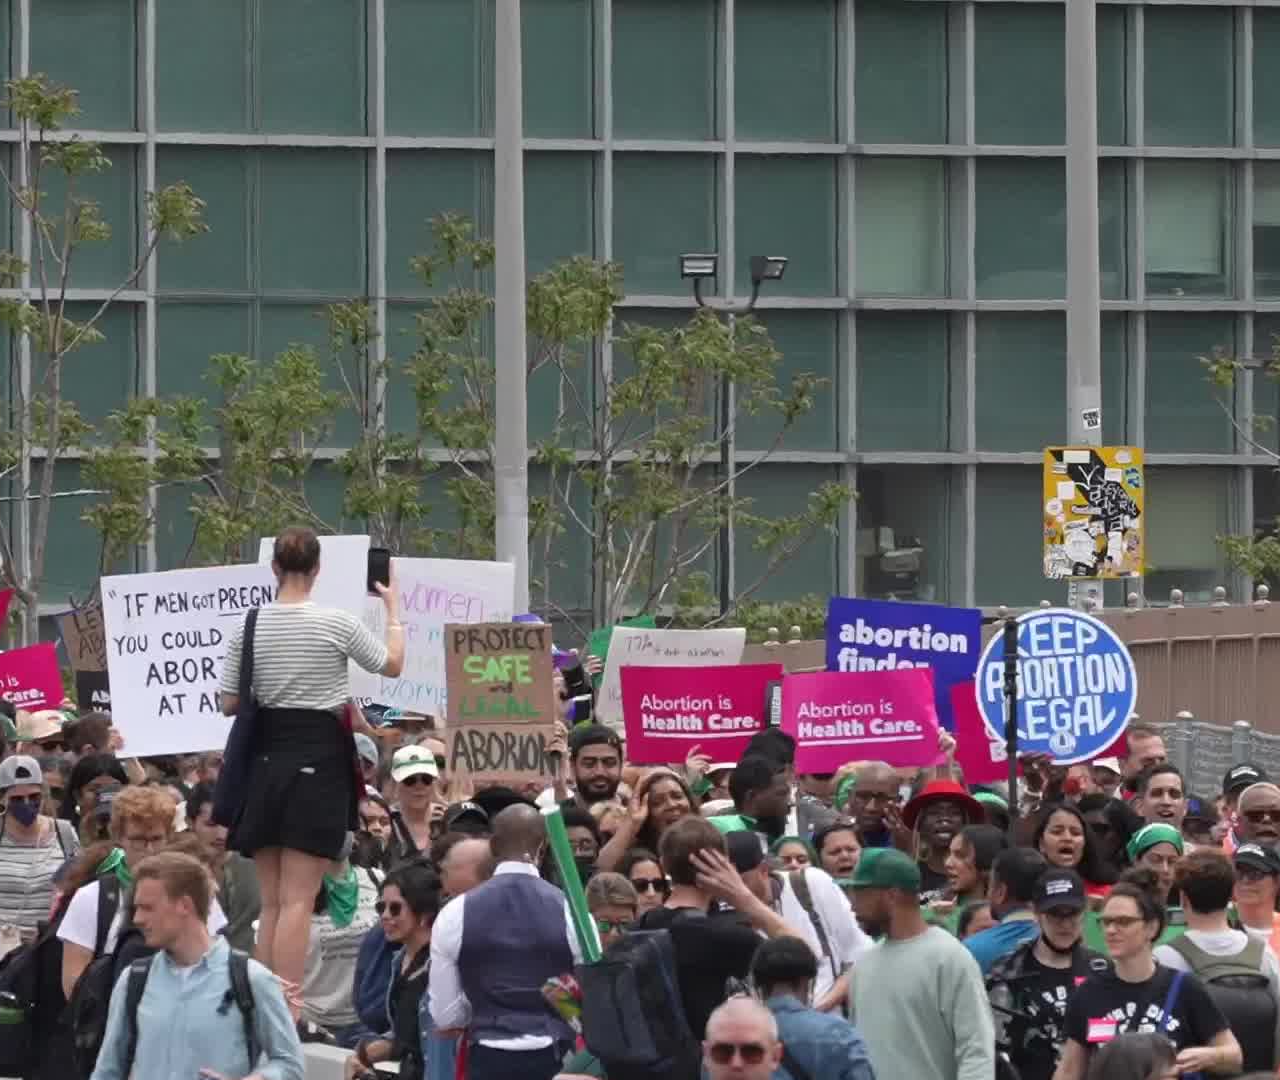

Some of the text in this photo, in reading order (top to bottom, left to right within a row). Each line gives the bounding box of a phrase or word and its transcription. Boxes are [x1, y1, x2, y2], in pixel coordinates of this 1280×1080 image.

[155, 592, 188, 615] MEN
[193, 594, 216, 611] GOT
[219, 585, 272, 611] PREGN
[113, 634, 148, 657] YOU
[162, 629, 222, 651] COULD
[454, 628, 545, 653] PROTECT
[839, 618, 967, 654] abortion
[8, 674, 20, 688] is
[147, 657, 224, 687] ABOR
[463, 655, 533, 684] SAFE
[986, 653, 1127, 703] AORTION
[159, 694, 186, 717] AT
[641, 693, 733, 712] Abortion is
[798, 701, 875, 719] Abortion
[879, 699, 894, 715] is
[642, 713, 761, 731] Health Care.
[798, 719, 923, 738] Health Care.
[1002, 695, 1116, 740] LEGAL
